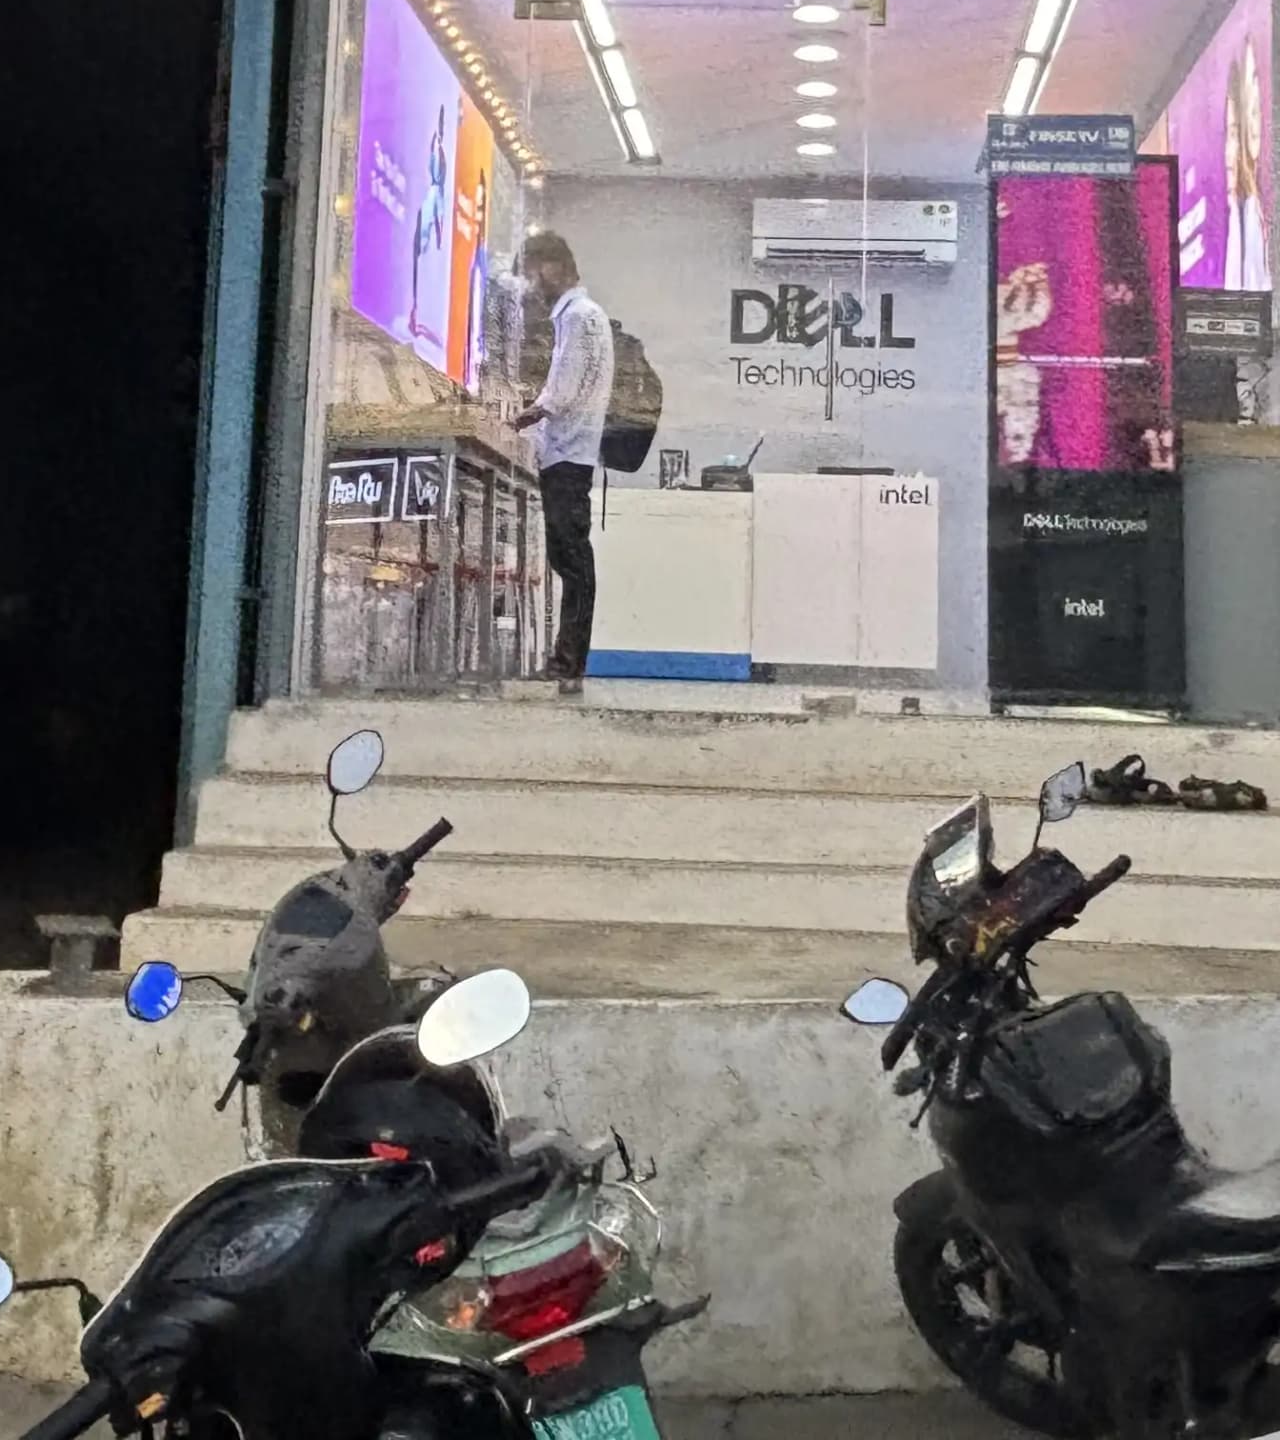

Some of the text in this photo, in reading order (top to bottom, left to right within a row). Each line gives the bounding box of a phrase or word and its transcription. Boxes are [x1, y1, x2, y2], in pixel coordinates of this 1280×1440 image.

[729, 356, 916, 396] Technologies
[879, 483, 931, 506] intel
[1064, 597, 1106, 617] intel
